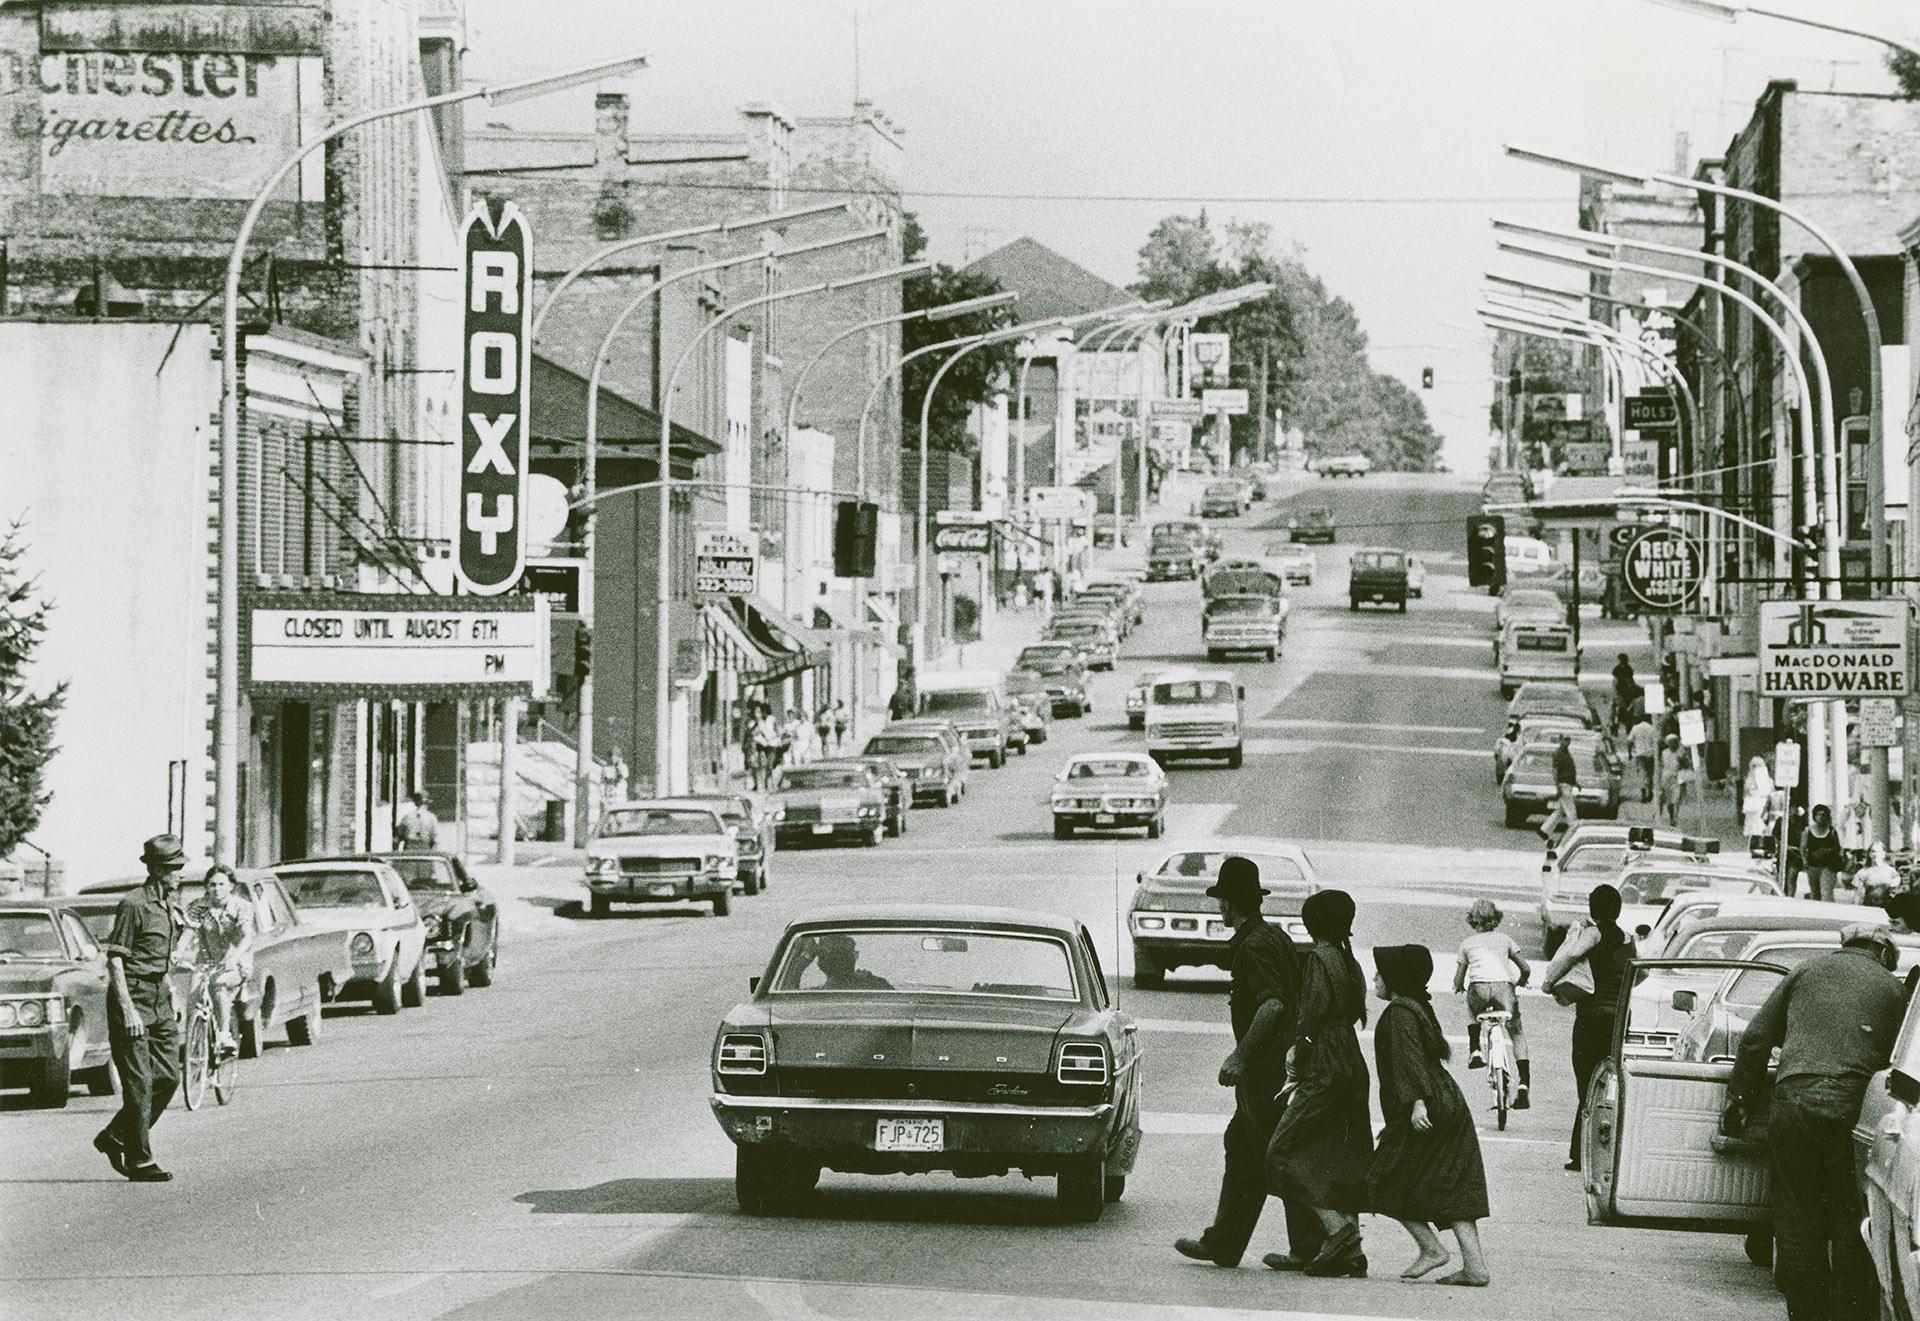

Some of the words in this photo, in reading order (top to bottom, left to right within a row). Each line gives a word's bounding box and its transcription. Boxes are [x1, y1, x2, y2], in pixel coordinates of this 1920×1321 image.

[466, 250, 519, 556] ROXY
[1634, 559, 1691, 578] WHITE
[284, 617, 344, 639] CLOSED
[354, 618, 394, 639] UNTIL
[405, 618, 461, 640] AUGUST
[471, 619, 498, 640] 6TH
[484, 654, 505, 674] PM
[1775, 654, 1894, 668] MacDONALD
[1765, 671, 1904, 691] HARDWARE
[815, 1052, 1007, 1063] FORD
